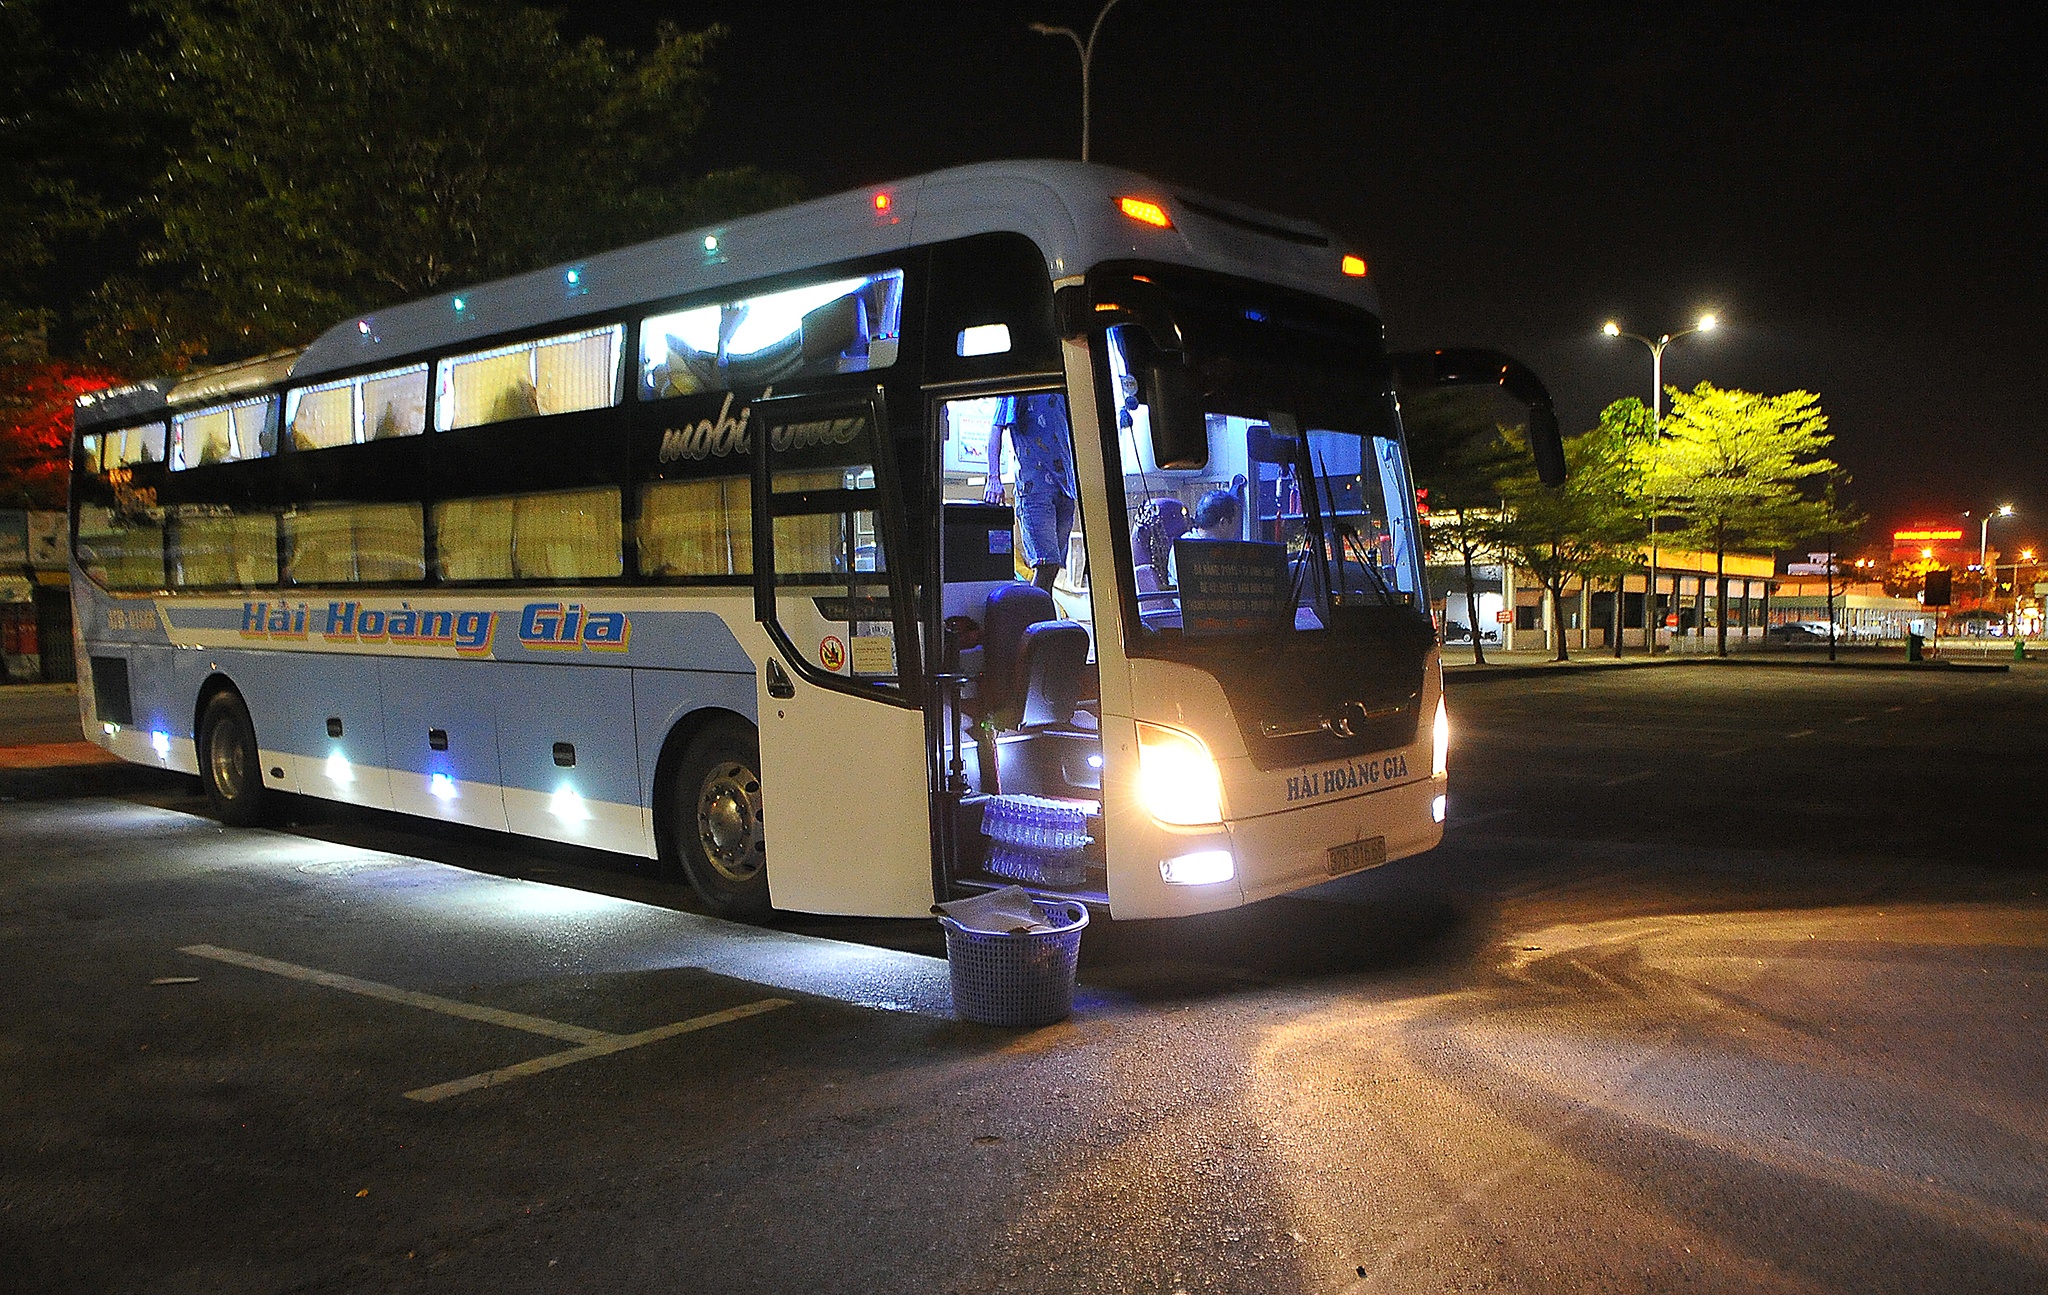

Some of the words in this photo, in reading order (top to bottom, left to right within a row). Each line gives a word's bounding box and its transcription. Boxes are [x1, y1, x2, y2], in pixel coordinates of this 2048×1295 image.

[323, 600, 498, 657] Hoàng
[518, 602, 631, 653] Gia
[1323, 759, 1380, 794] HOÀNG
[1383, 755, 1408, 780] GIA
